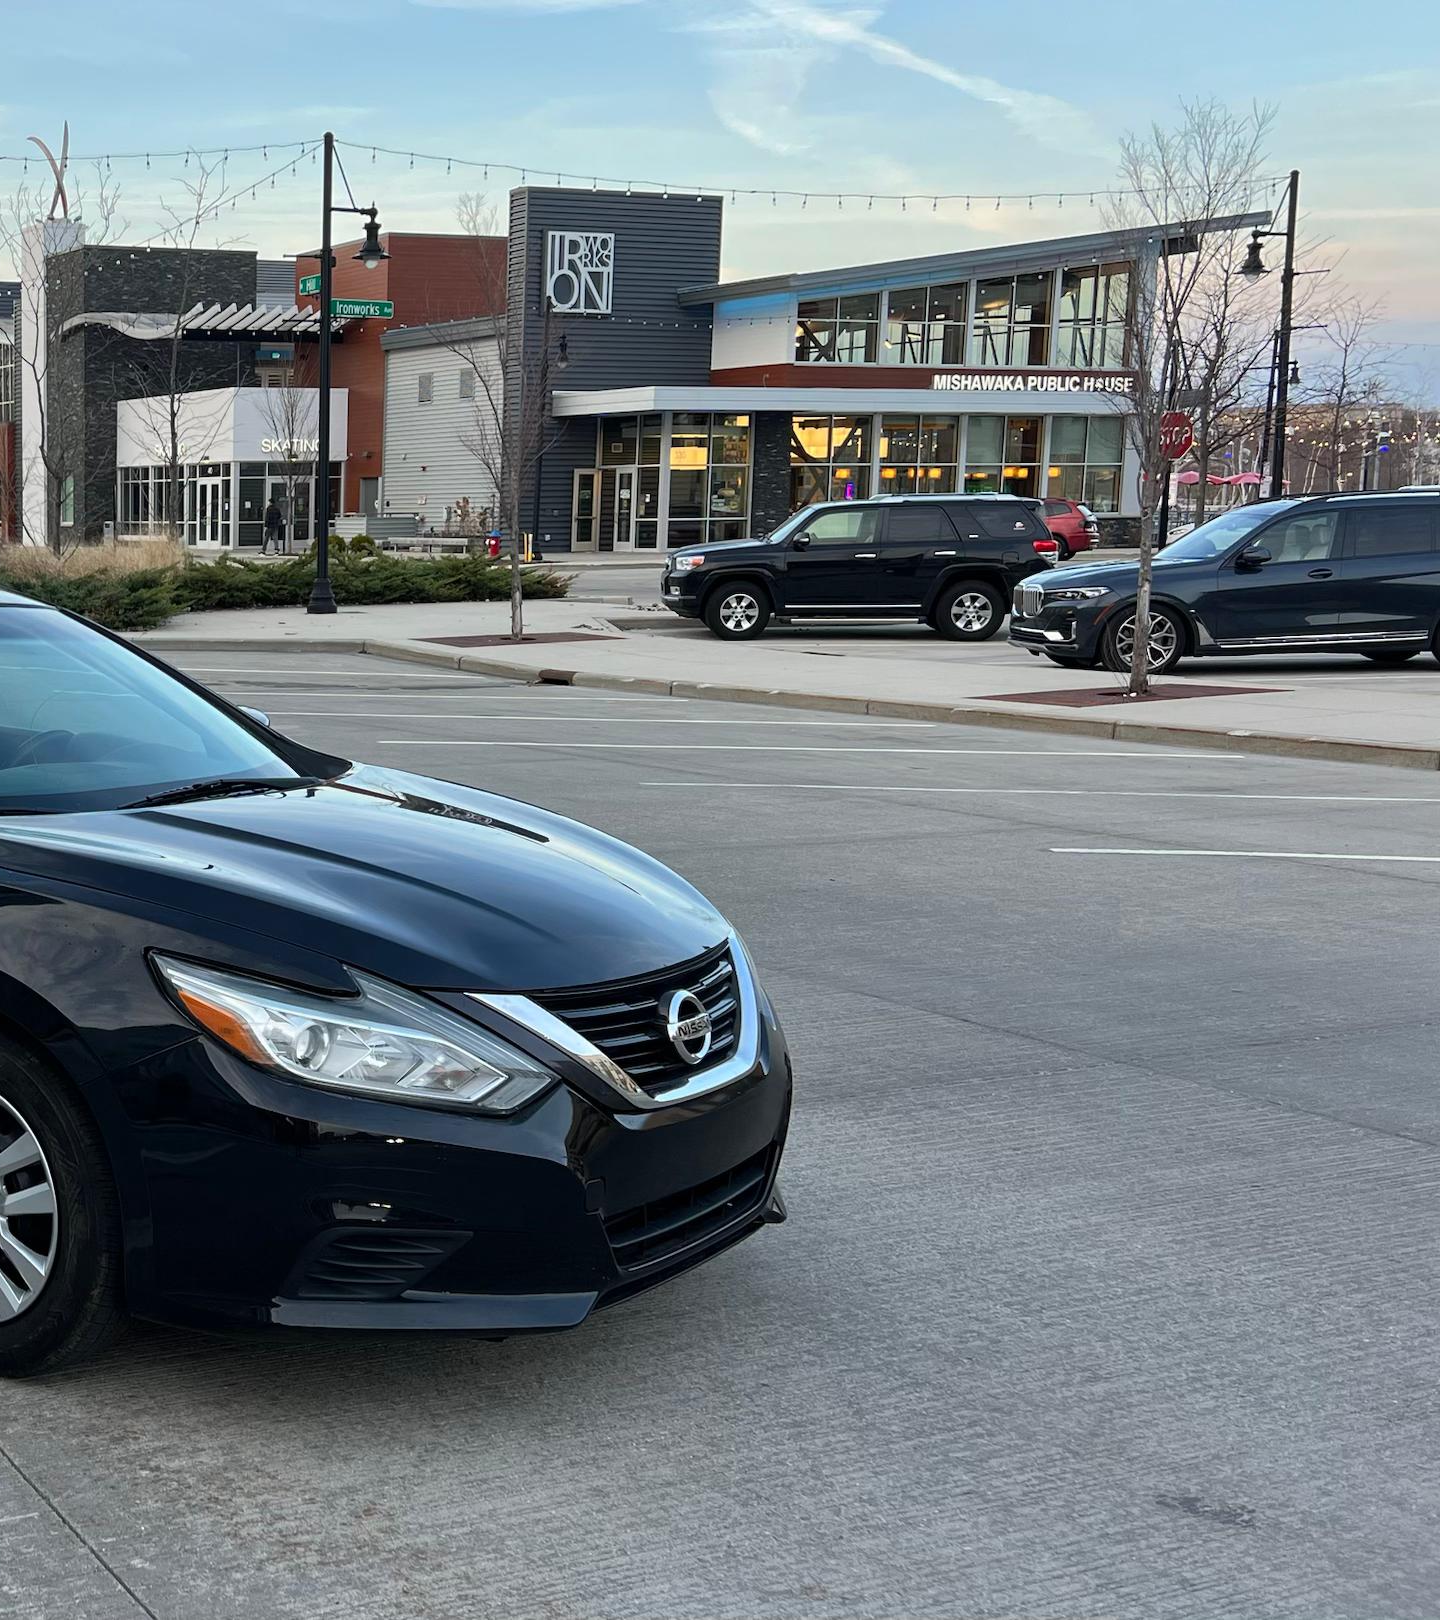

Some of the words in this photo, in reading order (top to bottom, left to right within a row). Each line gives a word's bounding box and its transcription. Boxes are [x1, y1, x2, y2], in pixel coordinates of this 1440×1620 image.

[336, 301, 380, 315] Ironworks
[933, 374, 1024, 391] MISHAWAKA
[1027, 375, 1080, 391] PUBLIC
